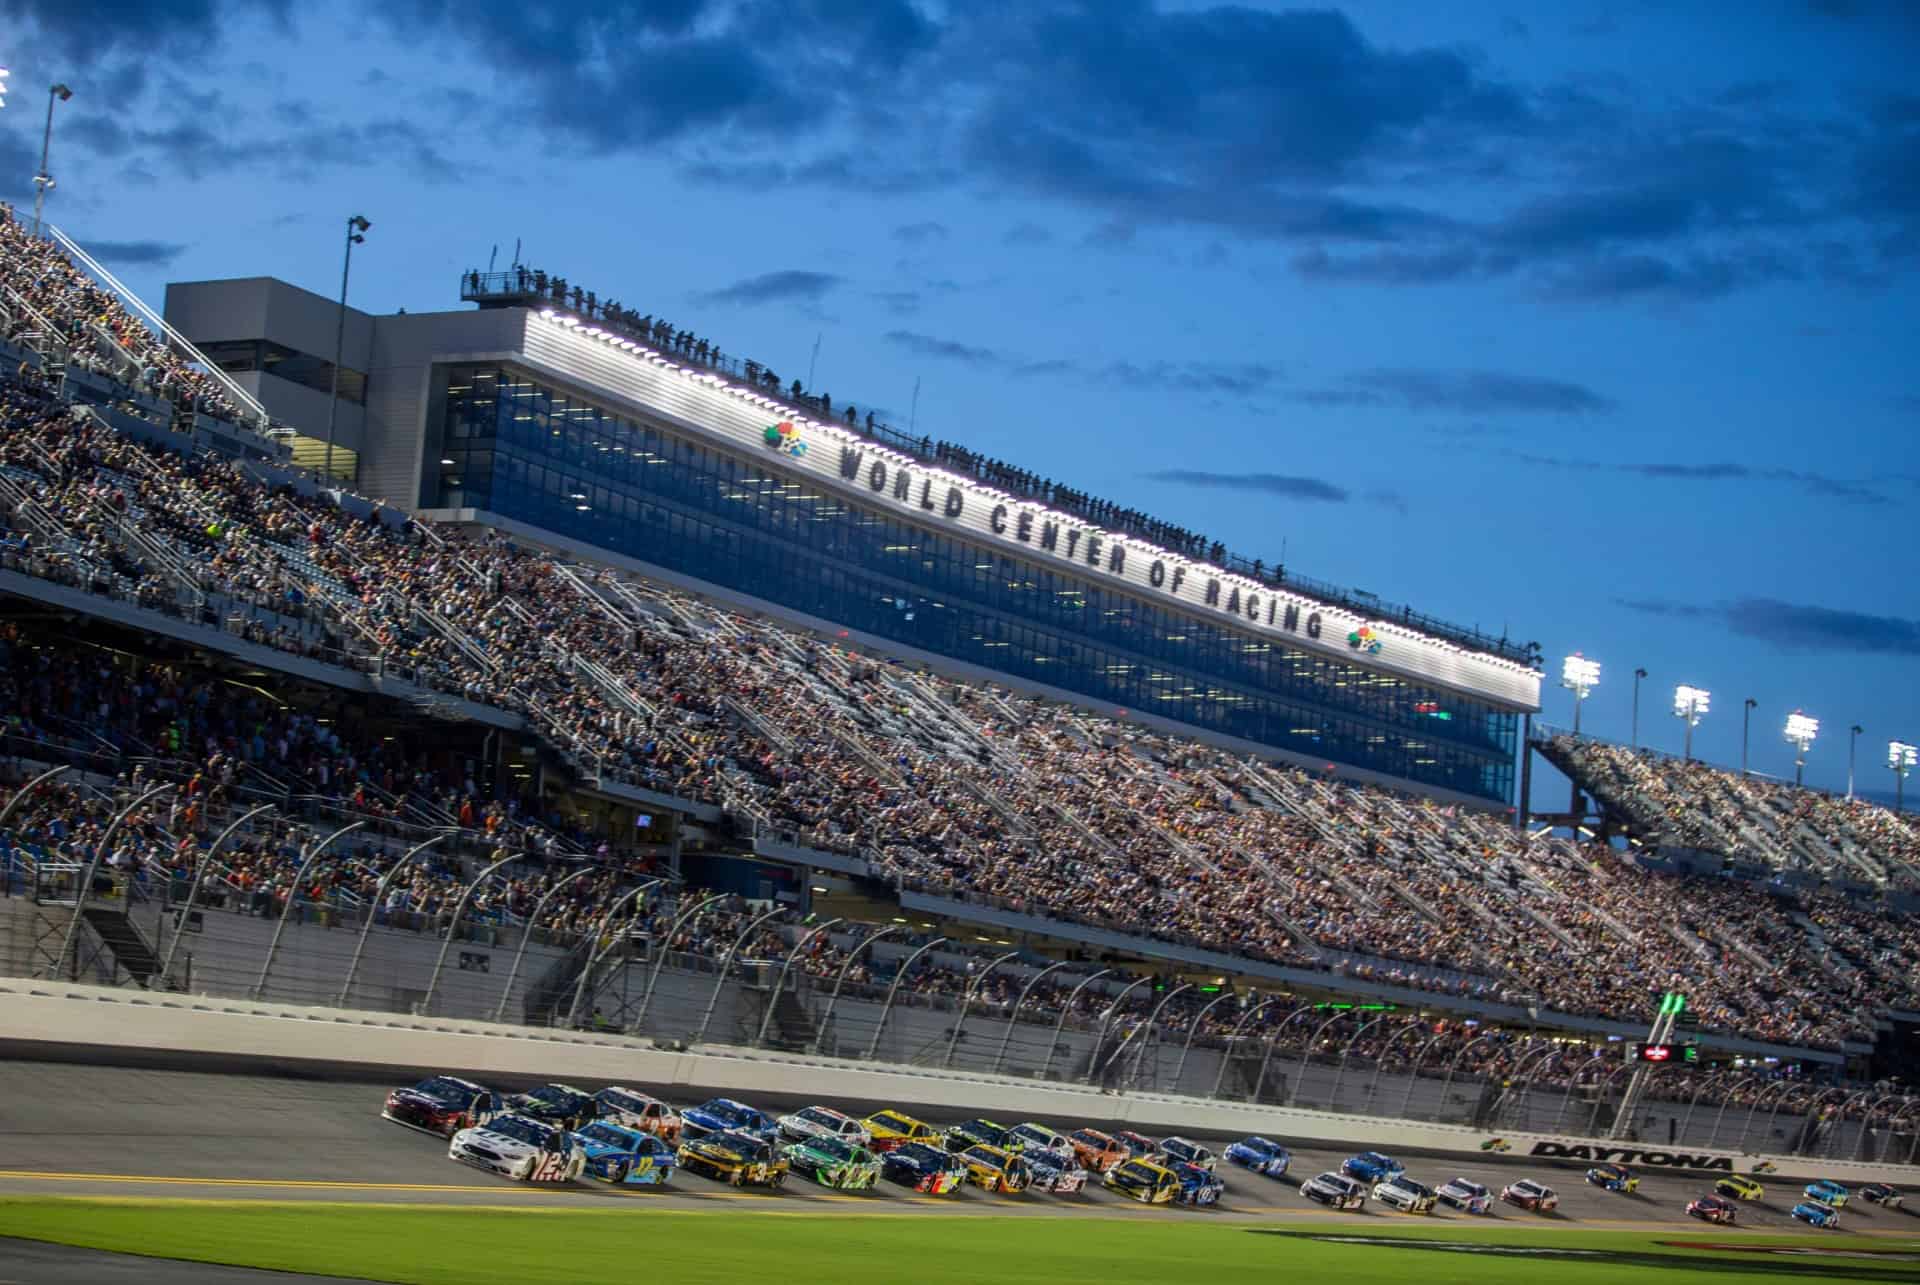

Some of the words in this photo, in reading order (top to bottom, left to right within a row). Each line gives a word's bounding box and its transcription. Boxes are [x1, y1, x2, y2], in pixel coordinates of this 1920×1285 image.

[841, 446, 963, 518] WORLD
[991, 503, 1126, 575] CENTER
[1151, 559, 1186, 593] OF
[1206, 578, 1322, 639] RACING
[1531, 1141, 1733, 1172] DAYTONA
